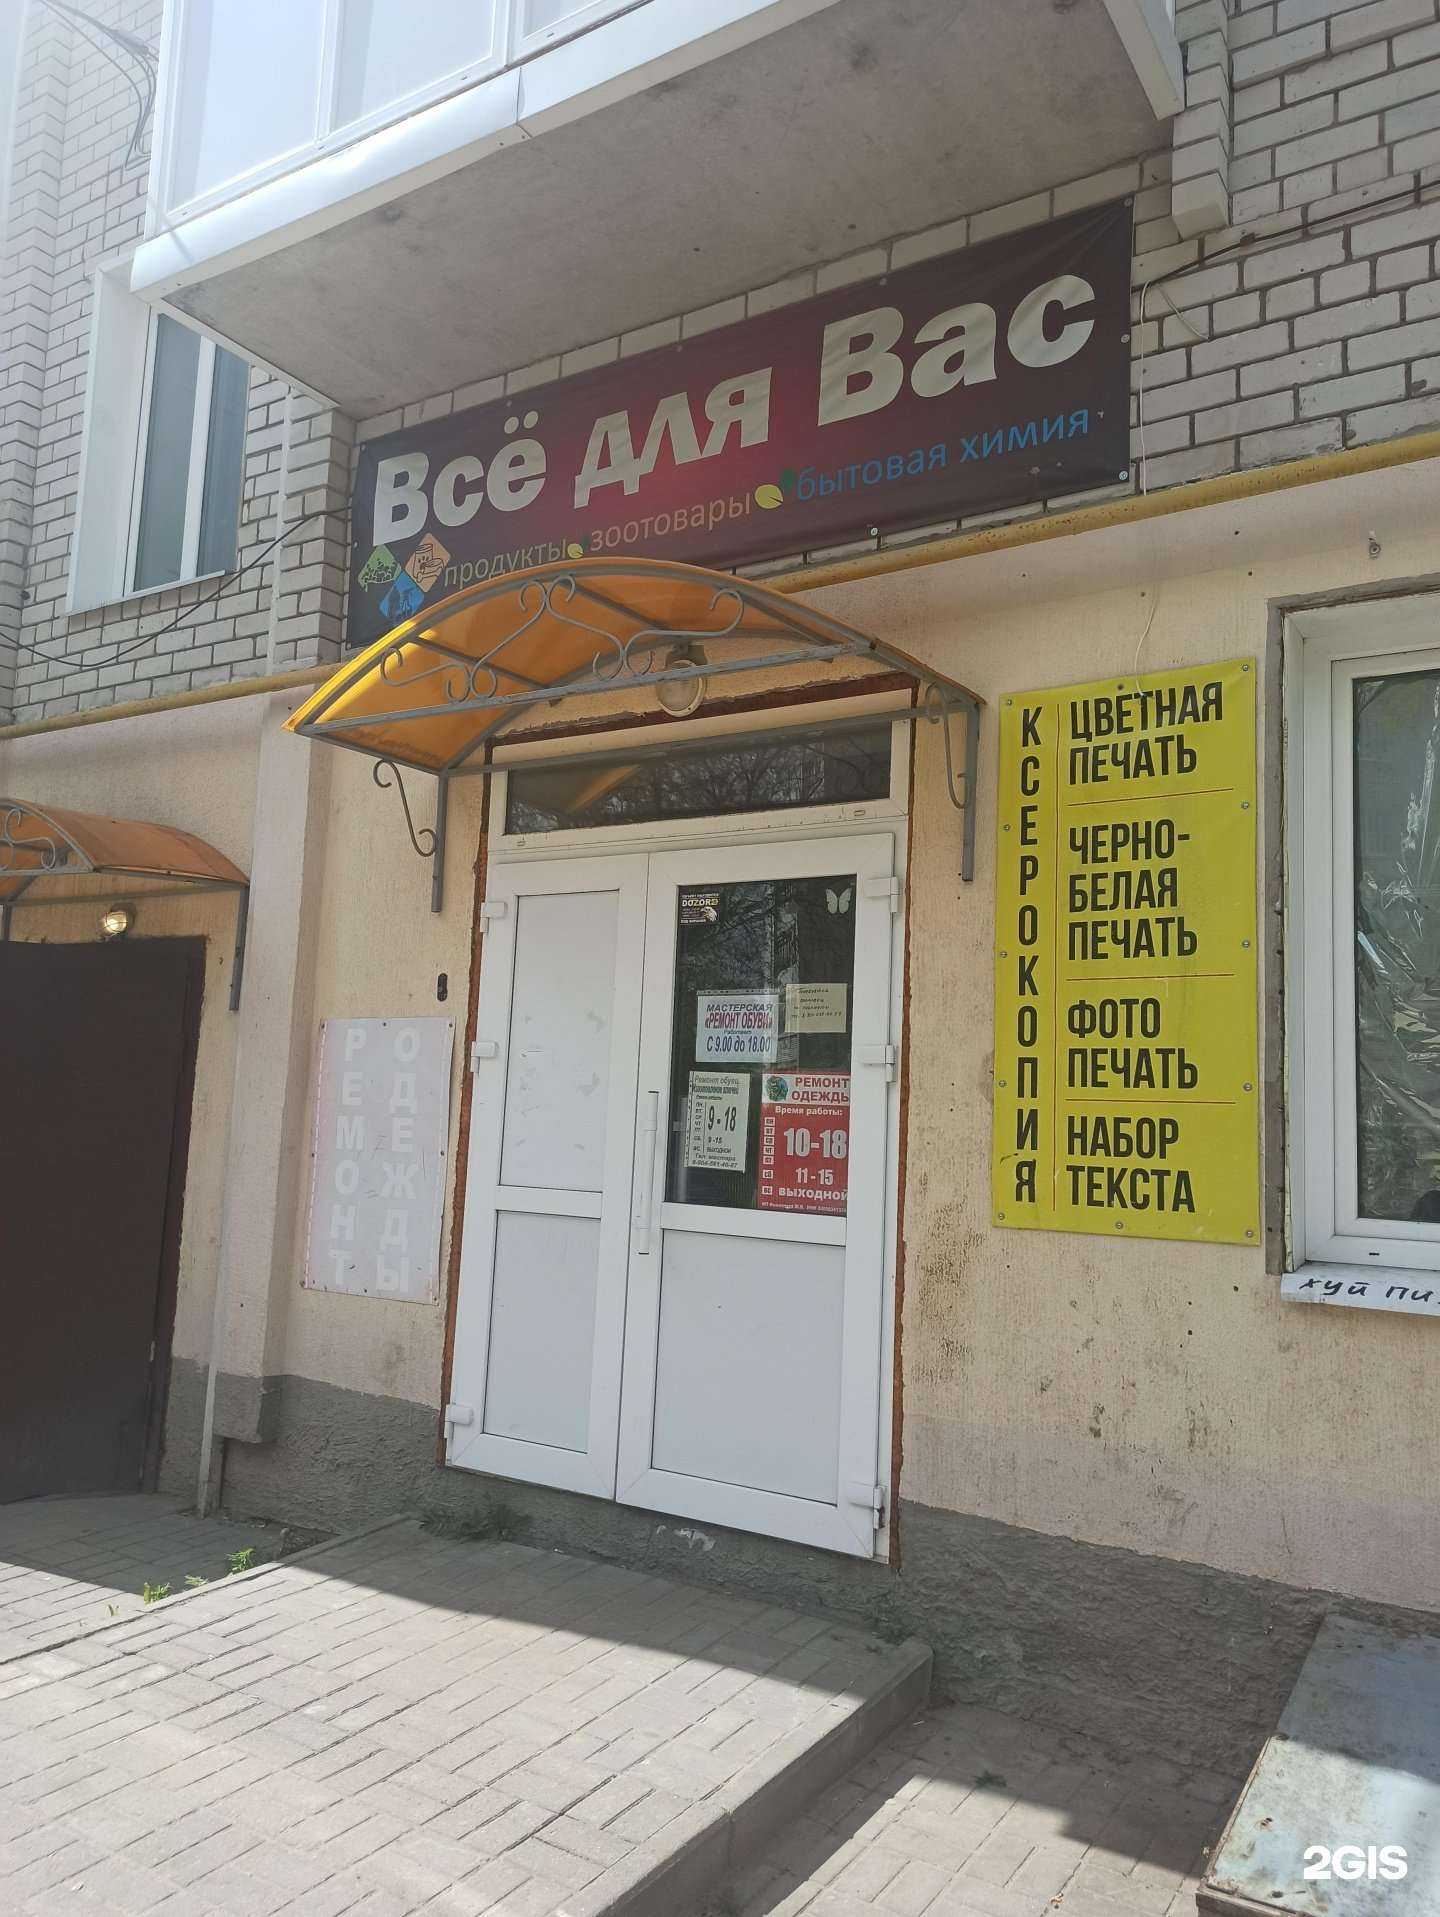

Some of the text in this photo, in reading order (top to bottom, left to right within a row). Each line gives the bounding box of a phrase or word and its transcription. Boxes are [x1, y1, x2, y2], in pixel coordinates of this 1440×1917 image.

[371, 274, 1097, 548] Всё для Вас
[797, 408, 1091, 502] бытовая химия
[590, 491, 752, 554] зоотовары
[444, 539, 567, 589] продукты
[1070, 681, 1224, 742] ЦВЕТНАЯ
[1068, 735, 1198, 785] ПЕЧАТЬ
[1068, 818, 1191, 865] ЧЕРНО-
[1068, 867, 1179, 913] БЕЛАЯ
[1015, 706, 1043, 1204] КСЕРОКОПИЯ
[1067, 917, 1198, 961] ПЕЧАТЬ
[706, 1003, 774, 1012] МАСТЕРСКАЯ
[1067, 997, 1161, 1039] ФОТО
[715, 1036, 733, 1052] 9.00
[734, 1035, 746, 1052] до
[748, 1036, 771, 1052] 18.00
[795, 1077, 850, 1088] РЕМОНТ
[1067, 1047, 1199, 1090] ПЕЧАТЬ
[775, 1105, 843, 1117] Время работы:
[783, 1127, 847, 1159] 10-18
[1067, 1115, 1180, 1160] НАБОР
[1066, 1165, 1196, 1214] ТЕКСТА
[1299, 1278, 1440, 1305] хуй пи
